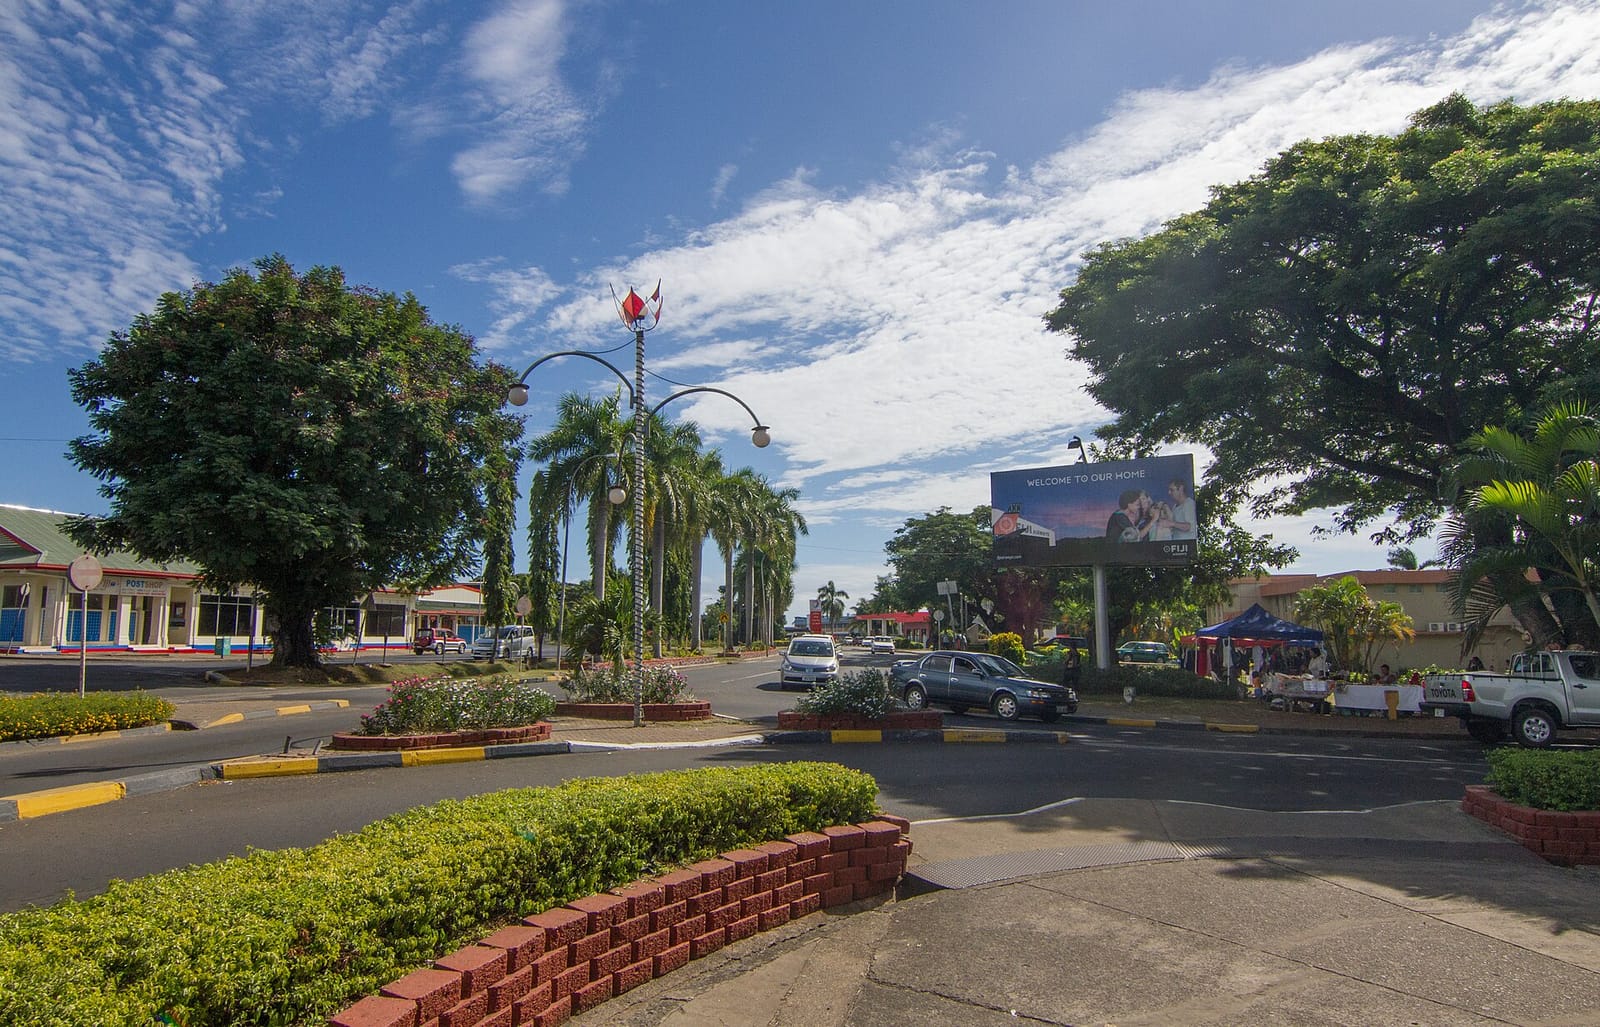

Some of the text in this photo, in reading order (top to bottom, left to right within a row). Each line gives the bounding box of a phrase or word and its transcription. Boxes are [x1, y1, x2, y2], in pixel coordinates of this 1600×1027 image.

[1026, 469, 1145, 487] WELCOME TO OUR HOME
[1171, 544, 1188, 552] FIJI
[1431, 689, 1456, 698] TOYOTA
